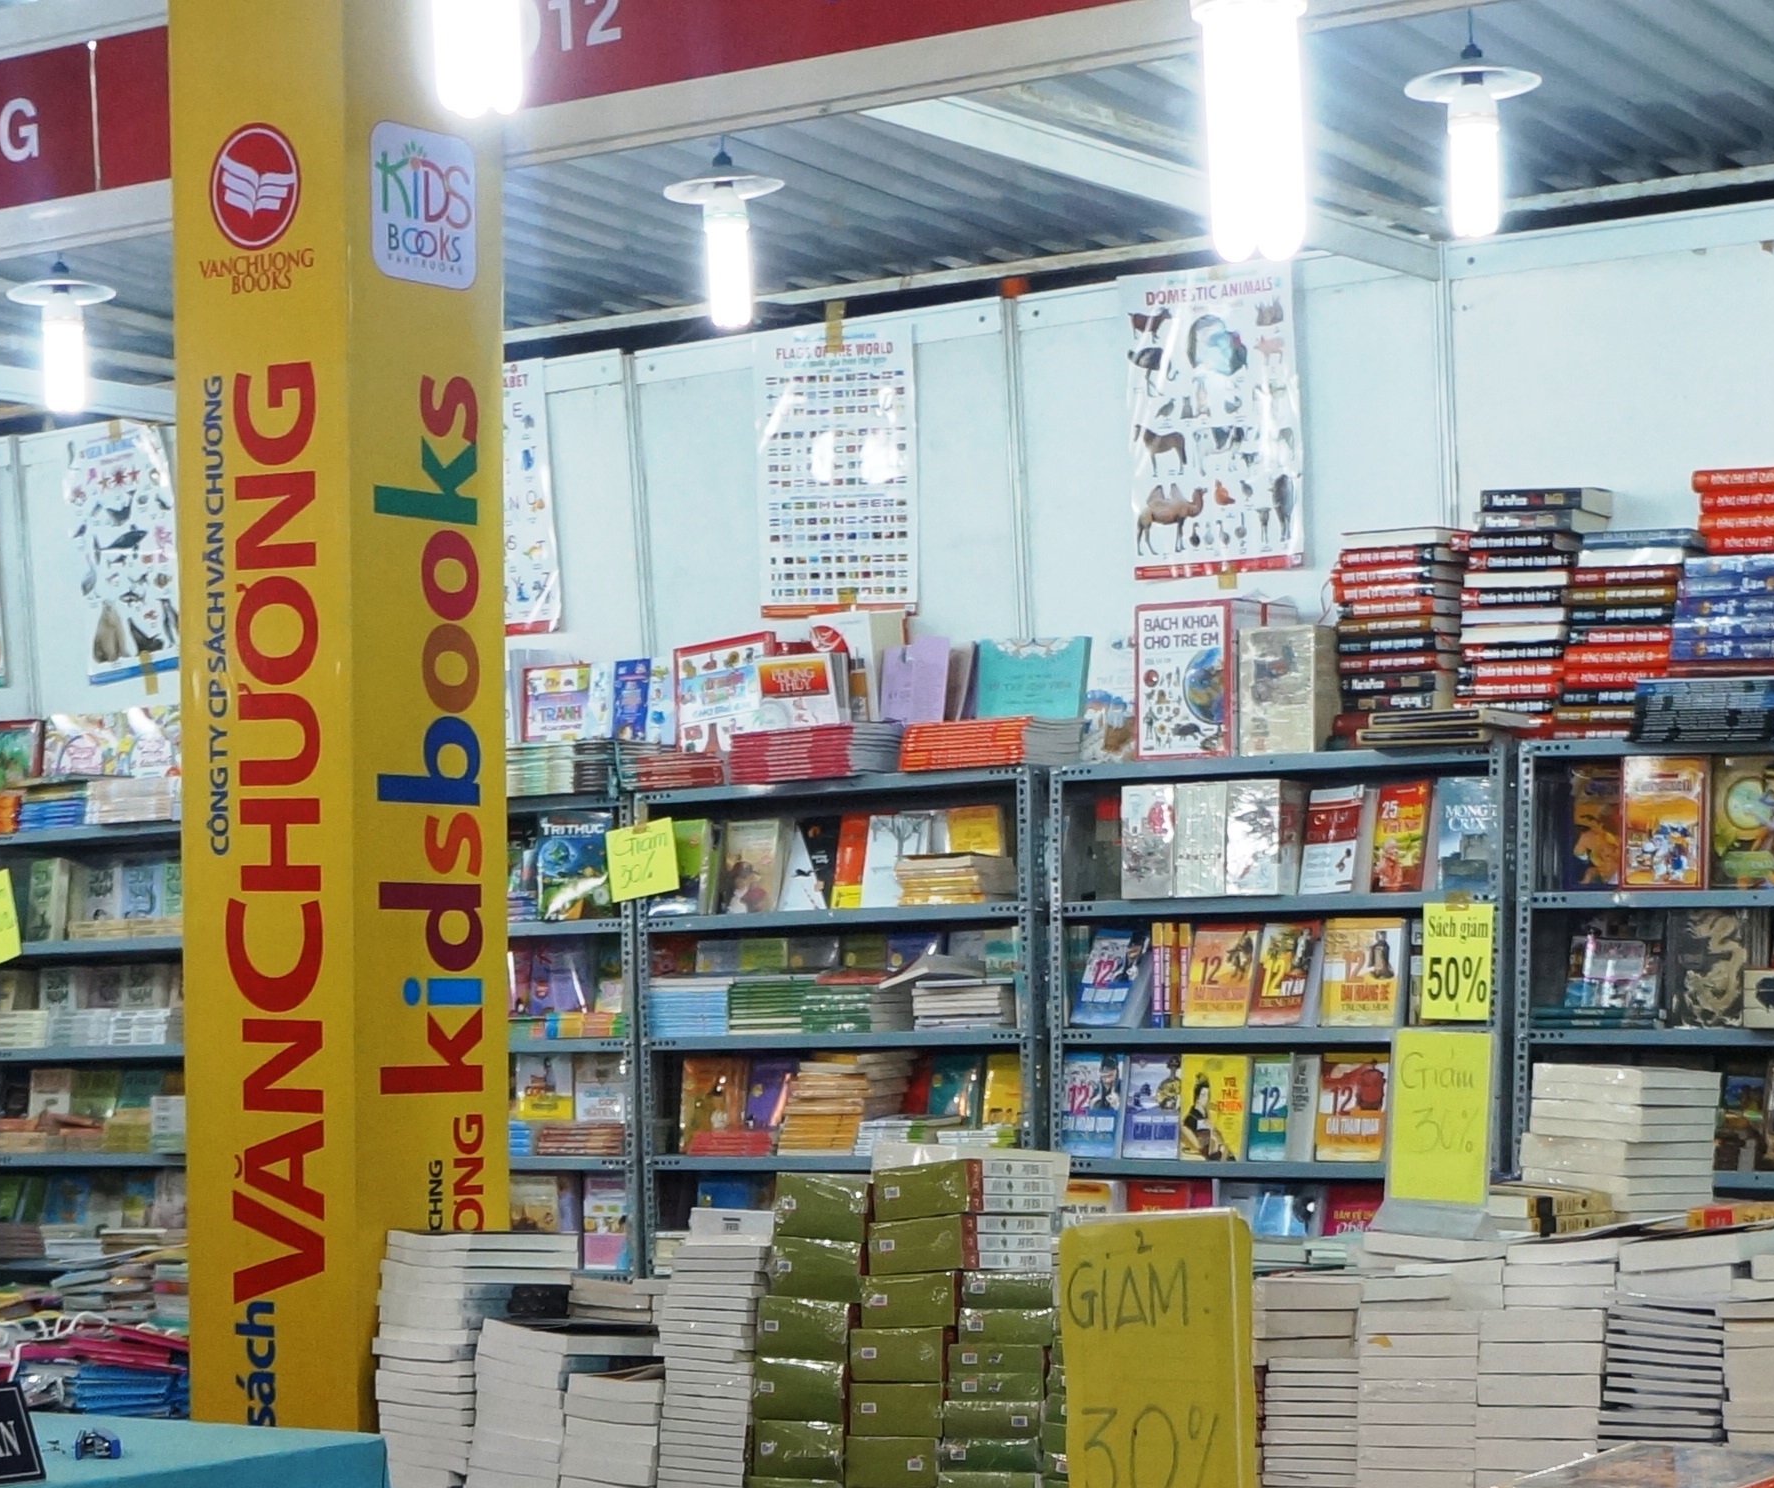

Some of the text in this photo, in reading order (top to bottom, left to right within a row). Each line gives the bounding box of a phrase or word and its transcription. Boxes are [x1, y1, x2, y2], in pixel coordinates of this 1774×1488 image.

[387, 222, 462, 263] BOOKS
[231, 272, 292, 295] BOOKS
[1221, 276, 1274, 298] ANIMALS
[855, 342, 894, 357] WORLD
[200, 374, 230, 857] CÔNG TY CP SÁCH VĂN CHƯƠNG
[1144, 614, 1219, 632] BÁCH KHOA
[1144, 636, 1170, 650] CHO
[1201, 632, 1219, 646] EM
[771, 668, 815, 684] PHONG
[538, 706, 583, 721] TRANH
[373, 375, 485, 1096] kidsbooks
[1381, 800, 1399, 820] 25
[1427, 914, 1490, 944] Sách giảm
[1092, 958, 1115, 988] 12
[1199, 955, 1223, 986] 12
[1261, 957, 1286, 997] 12
[1343, 951, 1365, 984] 12
[1426, 955, 1488, 1004] 50%
[1068, 1084, 1090, 1115] 12
[1261, 1087, 1281, 1116] 12
[1330, 1085, 1353, 1116] 12
[234, 1301, 277, 1428] sách
